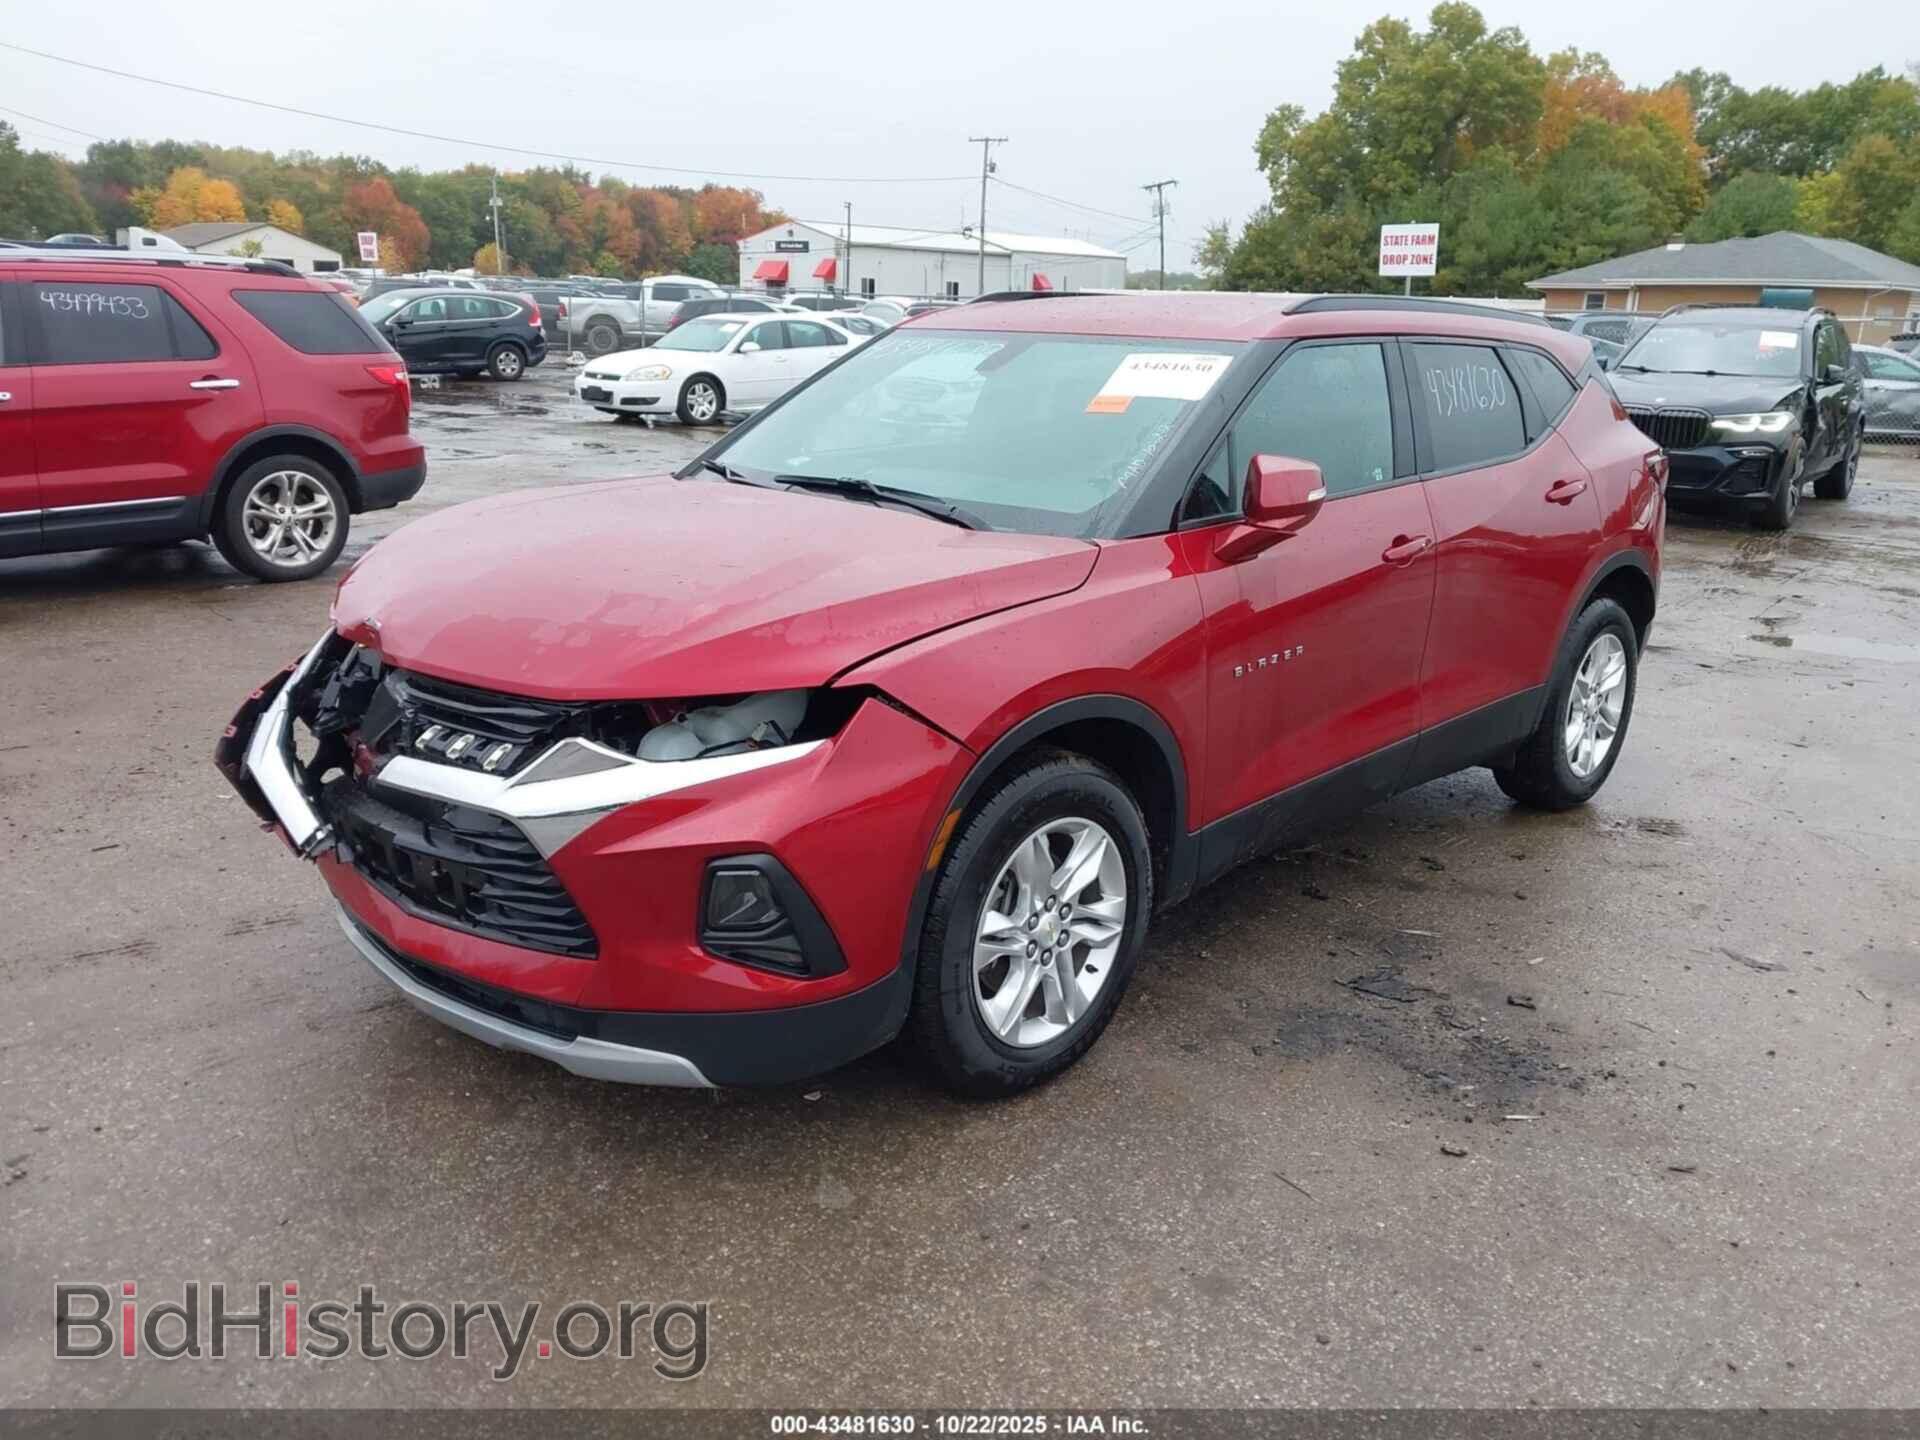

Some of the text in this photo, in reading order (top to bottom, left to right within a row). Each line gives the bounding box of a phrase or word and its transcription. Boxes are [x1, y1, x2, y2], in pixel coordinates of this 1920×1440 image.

[1383, 233, 1436, 246] STATE FARM
[1382, 254, 1434, 265] DROP ZONE
[1426, 363, 1505, 416] 43481630
[1234, 645, 1303, 677] BLAZER
